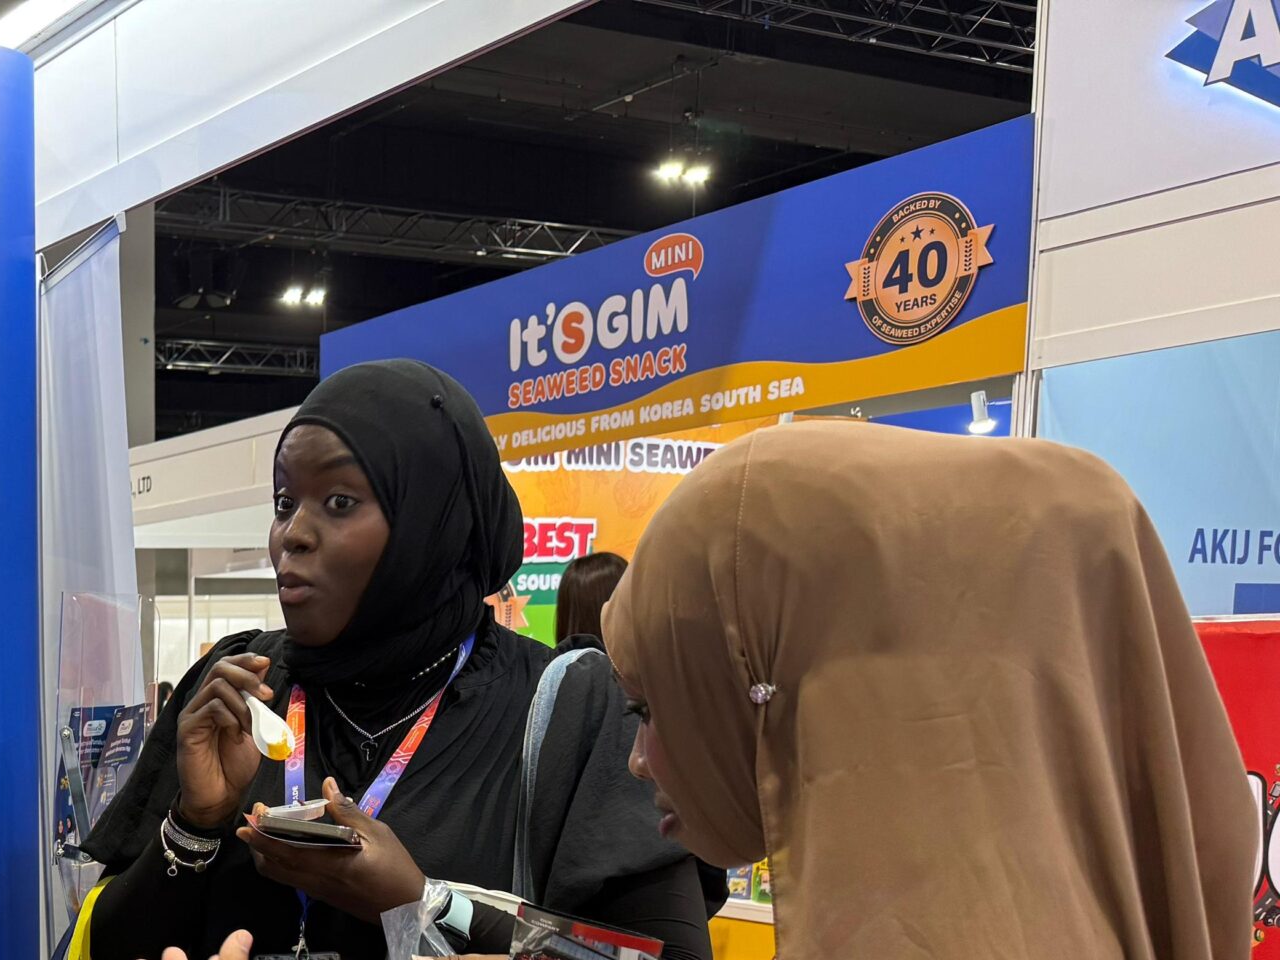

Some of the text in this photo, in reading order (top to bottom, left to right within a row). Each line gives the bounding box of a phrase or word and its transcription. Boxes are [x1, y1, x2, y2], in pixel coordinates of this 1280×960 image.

[892, 199, 942, 223] BACKED BY
[651, 241, 694, 270] MINI
[882, 240, 948, 295] 40
[597, 277, 688, 349] GIM
[872, 290, 962, 338] OF SEAWEED EXPERTISE
[895, 293, 937, 313] YEARS
[508, 343, 687, 408] SEAWEED SNACK
[512, 419, 586, 448] DELICIOUS
[591, 413, 635, 433] FROM
[640, 397, 694, 424] KOREA
[700, 384, 762, 414] SOUTH
[767, 377, 805, 401] SEA
[566, 441, 620, 466] MINI
[523, 522, 594, 557] BEST
[1188, 528, 1250, 565] AKIJ
